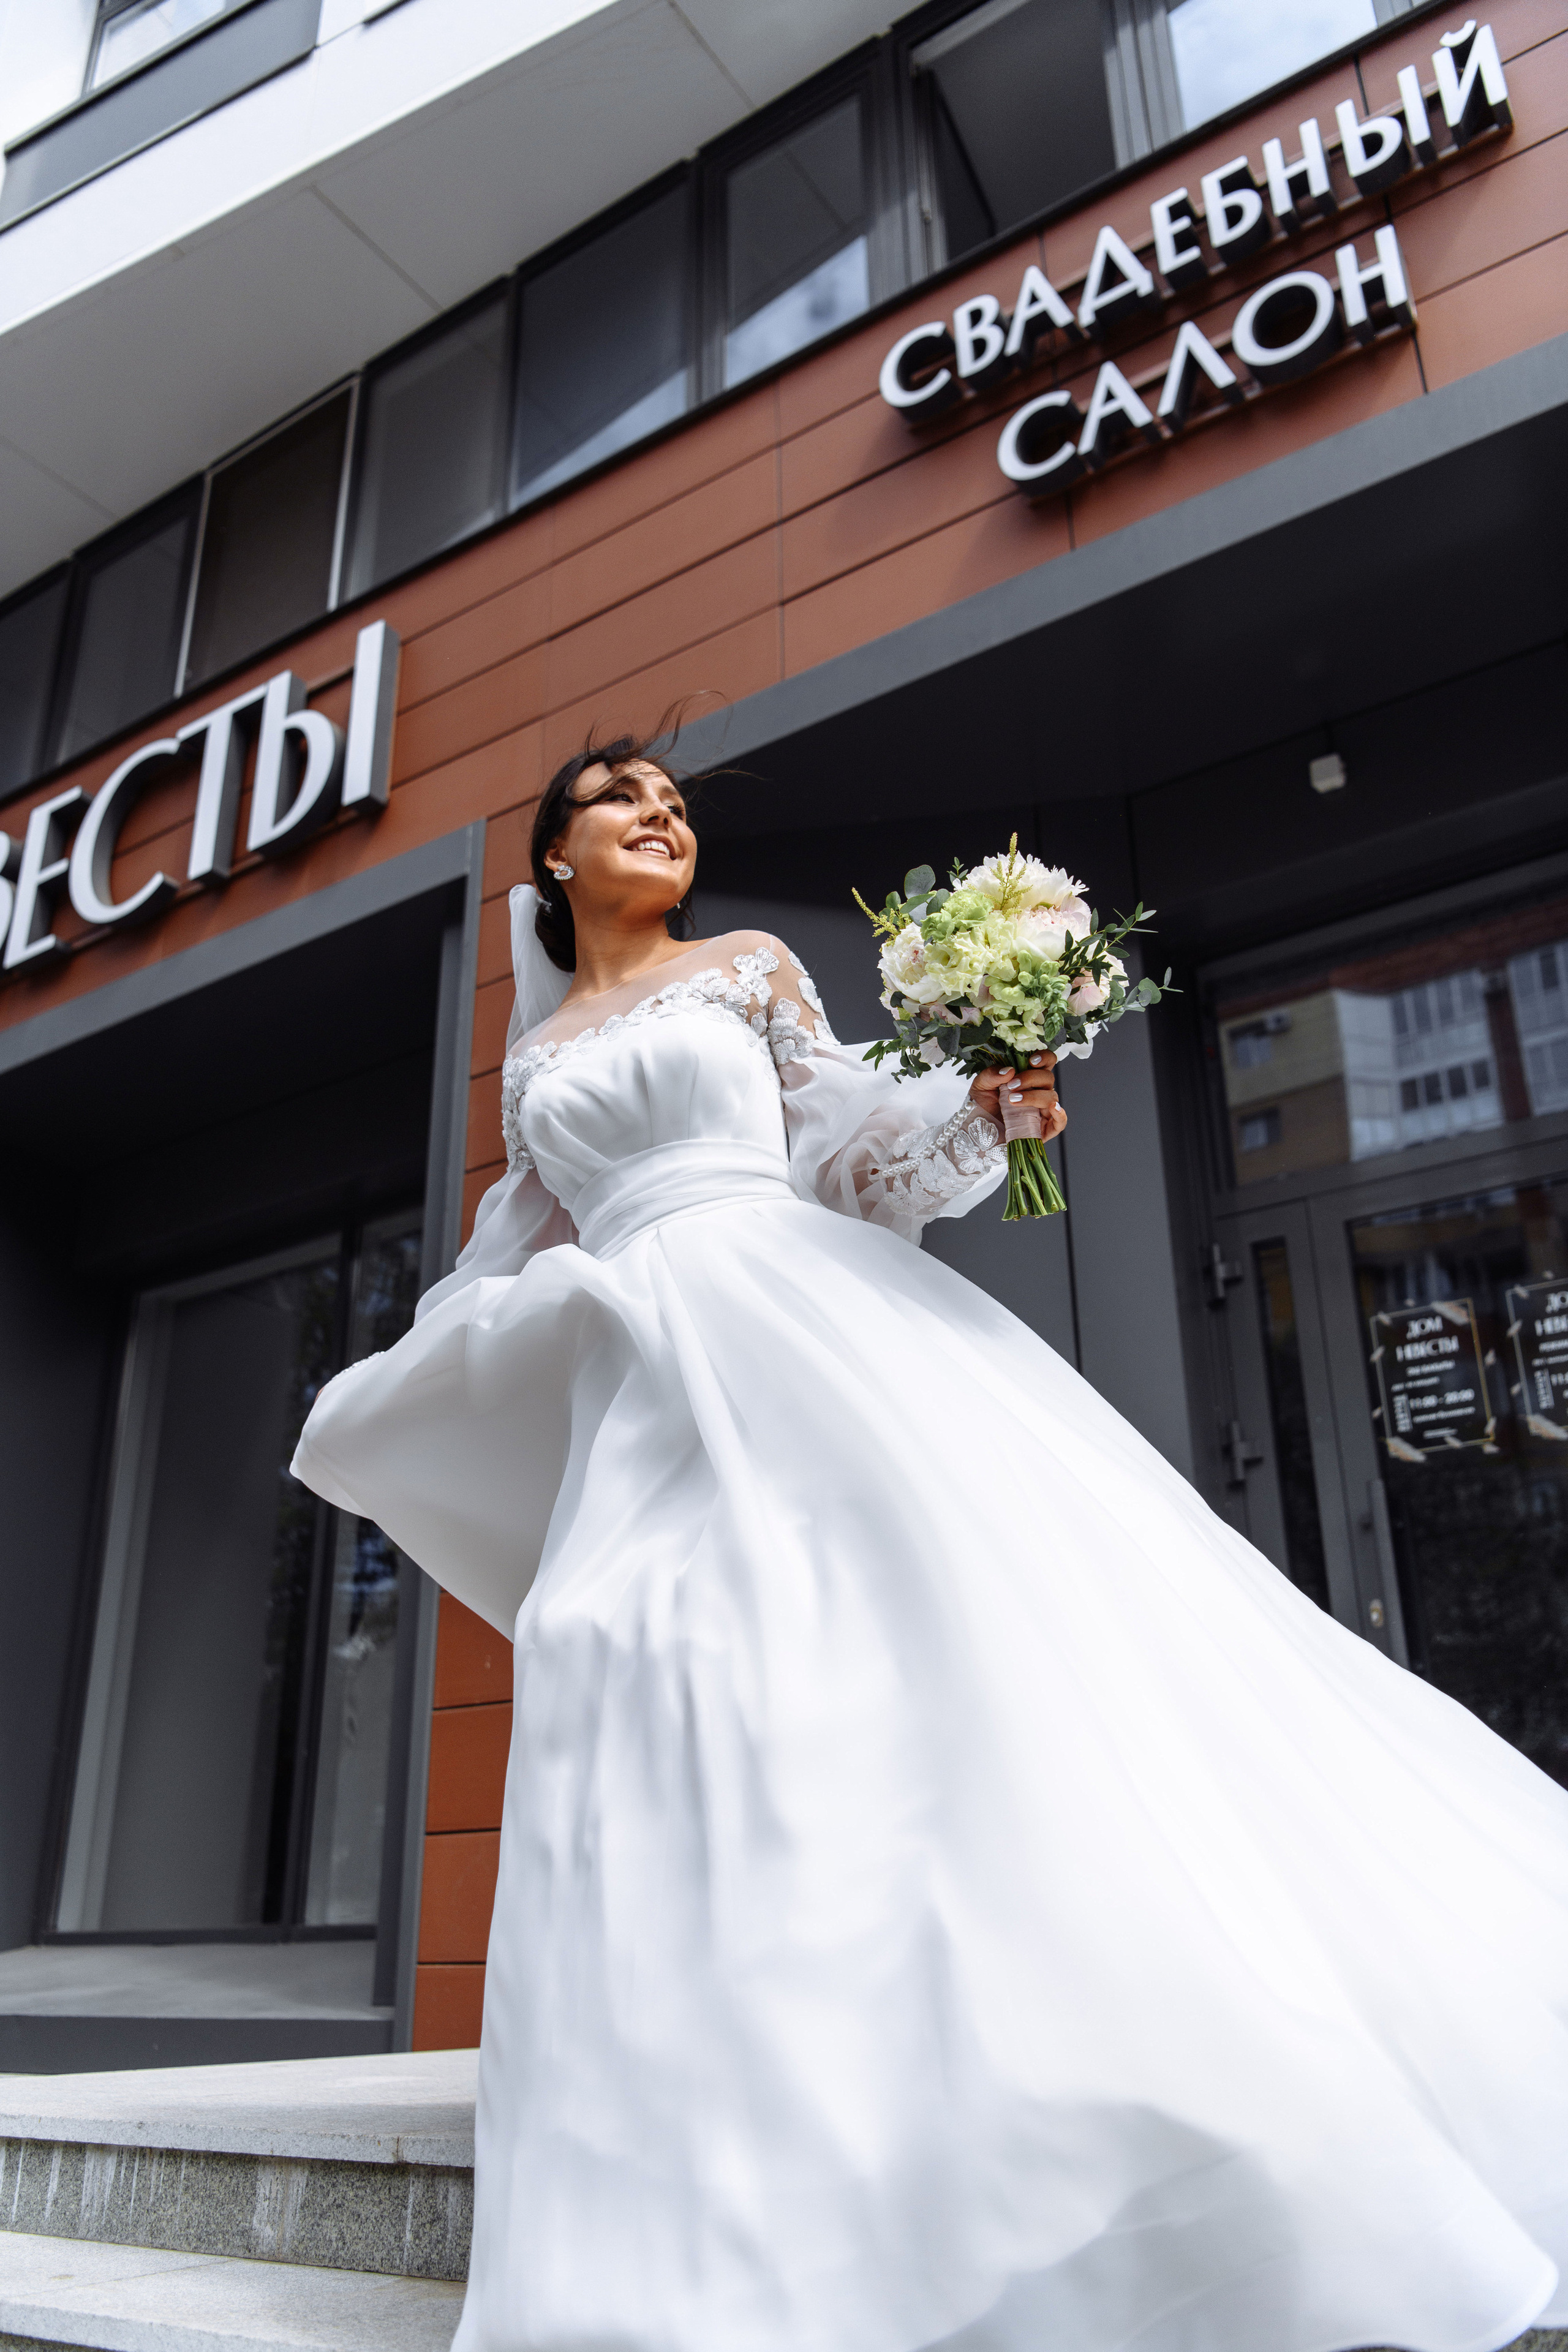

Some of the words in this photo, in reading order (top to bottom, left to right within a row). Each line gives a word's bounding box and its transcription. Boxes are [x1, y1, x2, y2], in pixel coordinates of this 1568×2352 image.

[878, 20, 1508, 409] СВАДЕБНЫЙ
[997, 224, 1409, 481] САЛОН
[1406, 1316, 1443, 1340] ДОМ
